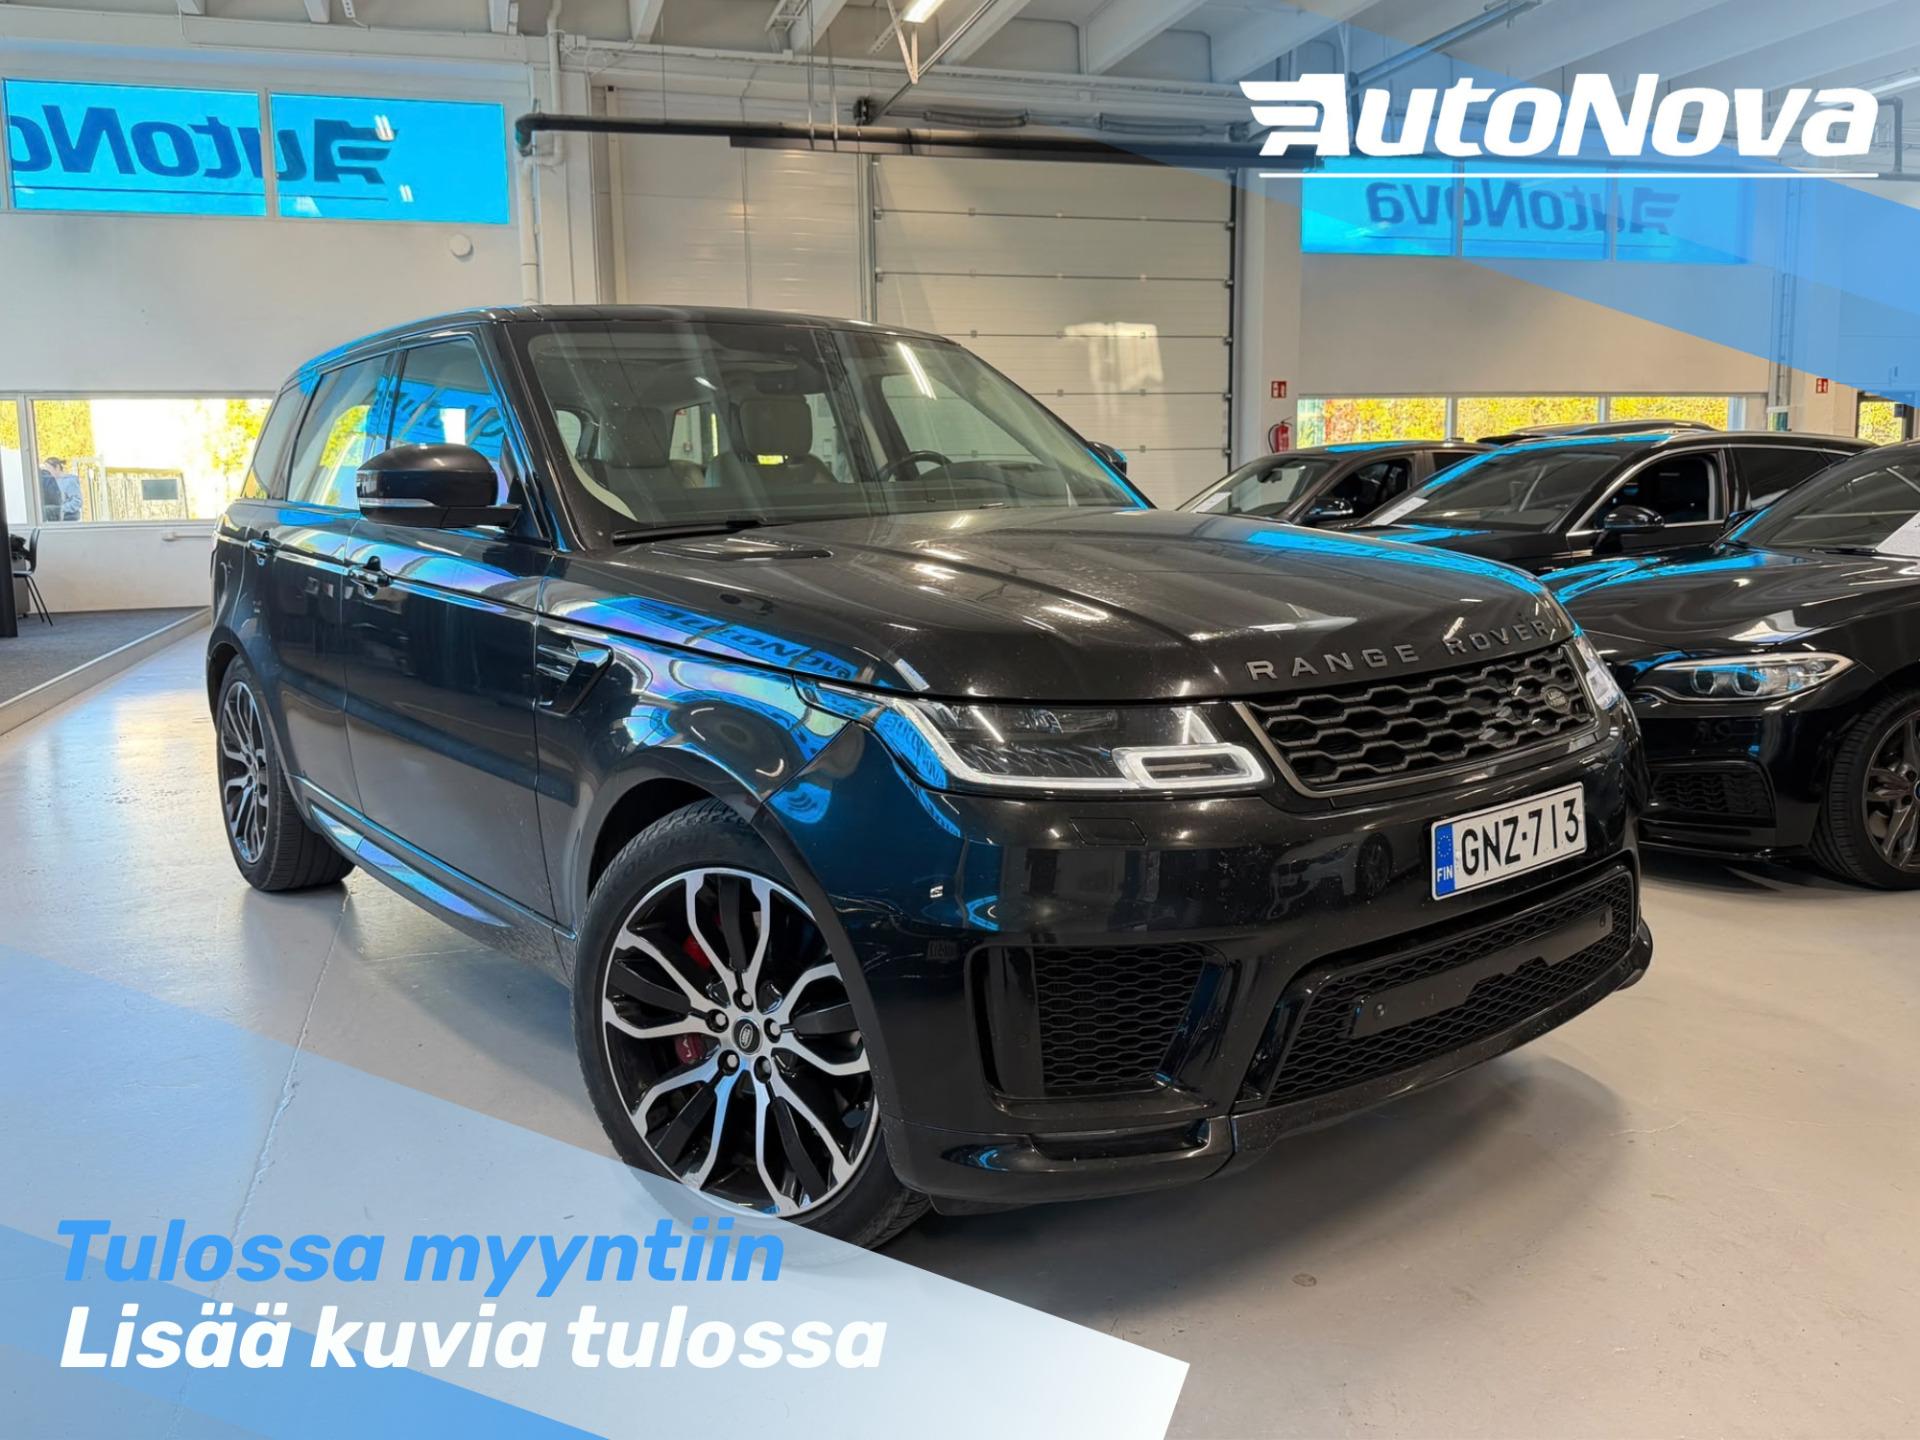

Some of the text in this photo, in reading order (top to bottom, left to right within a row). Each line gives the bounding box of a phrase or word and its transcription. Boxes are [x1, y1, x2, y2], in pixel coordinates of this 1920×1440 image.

[1246, 620, 1549, 681] RANGE ROVER
[1461, 798, 1579, 876] GNZ-713
[1437, 865, 1453, 882] FIN
